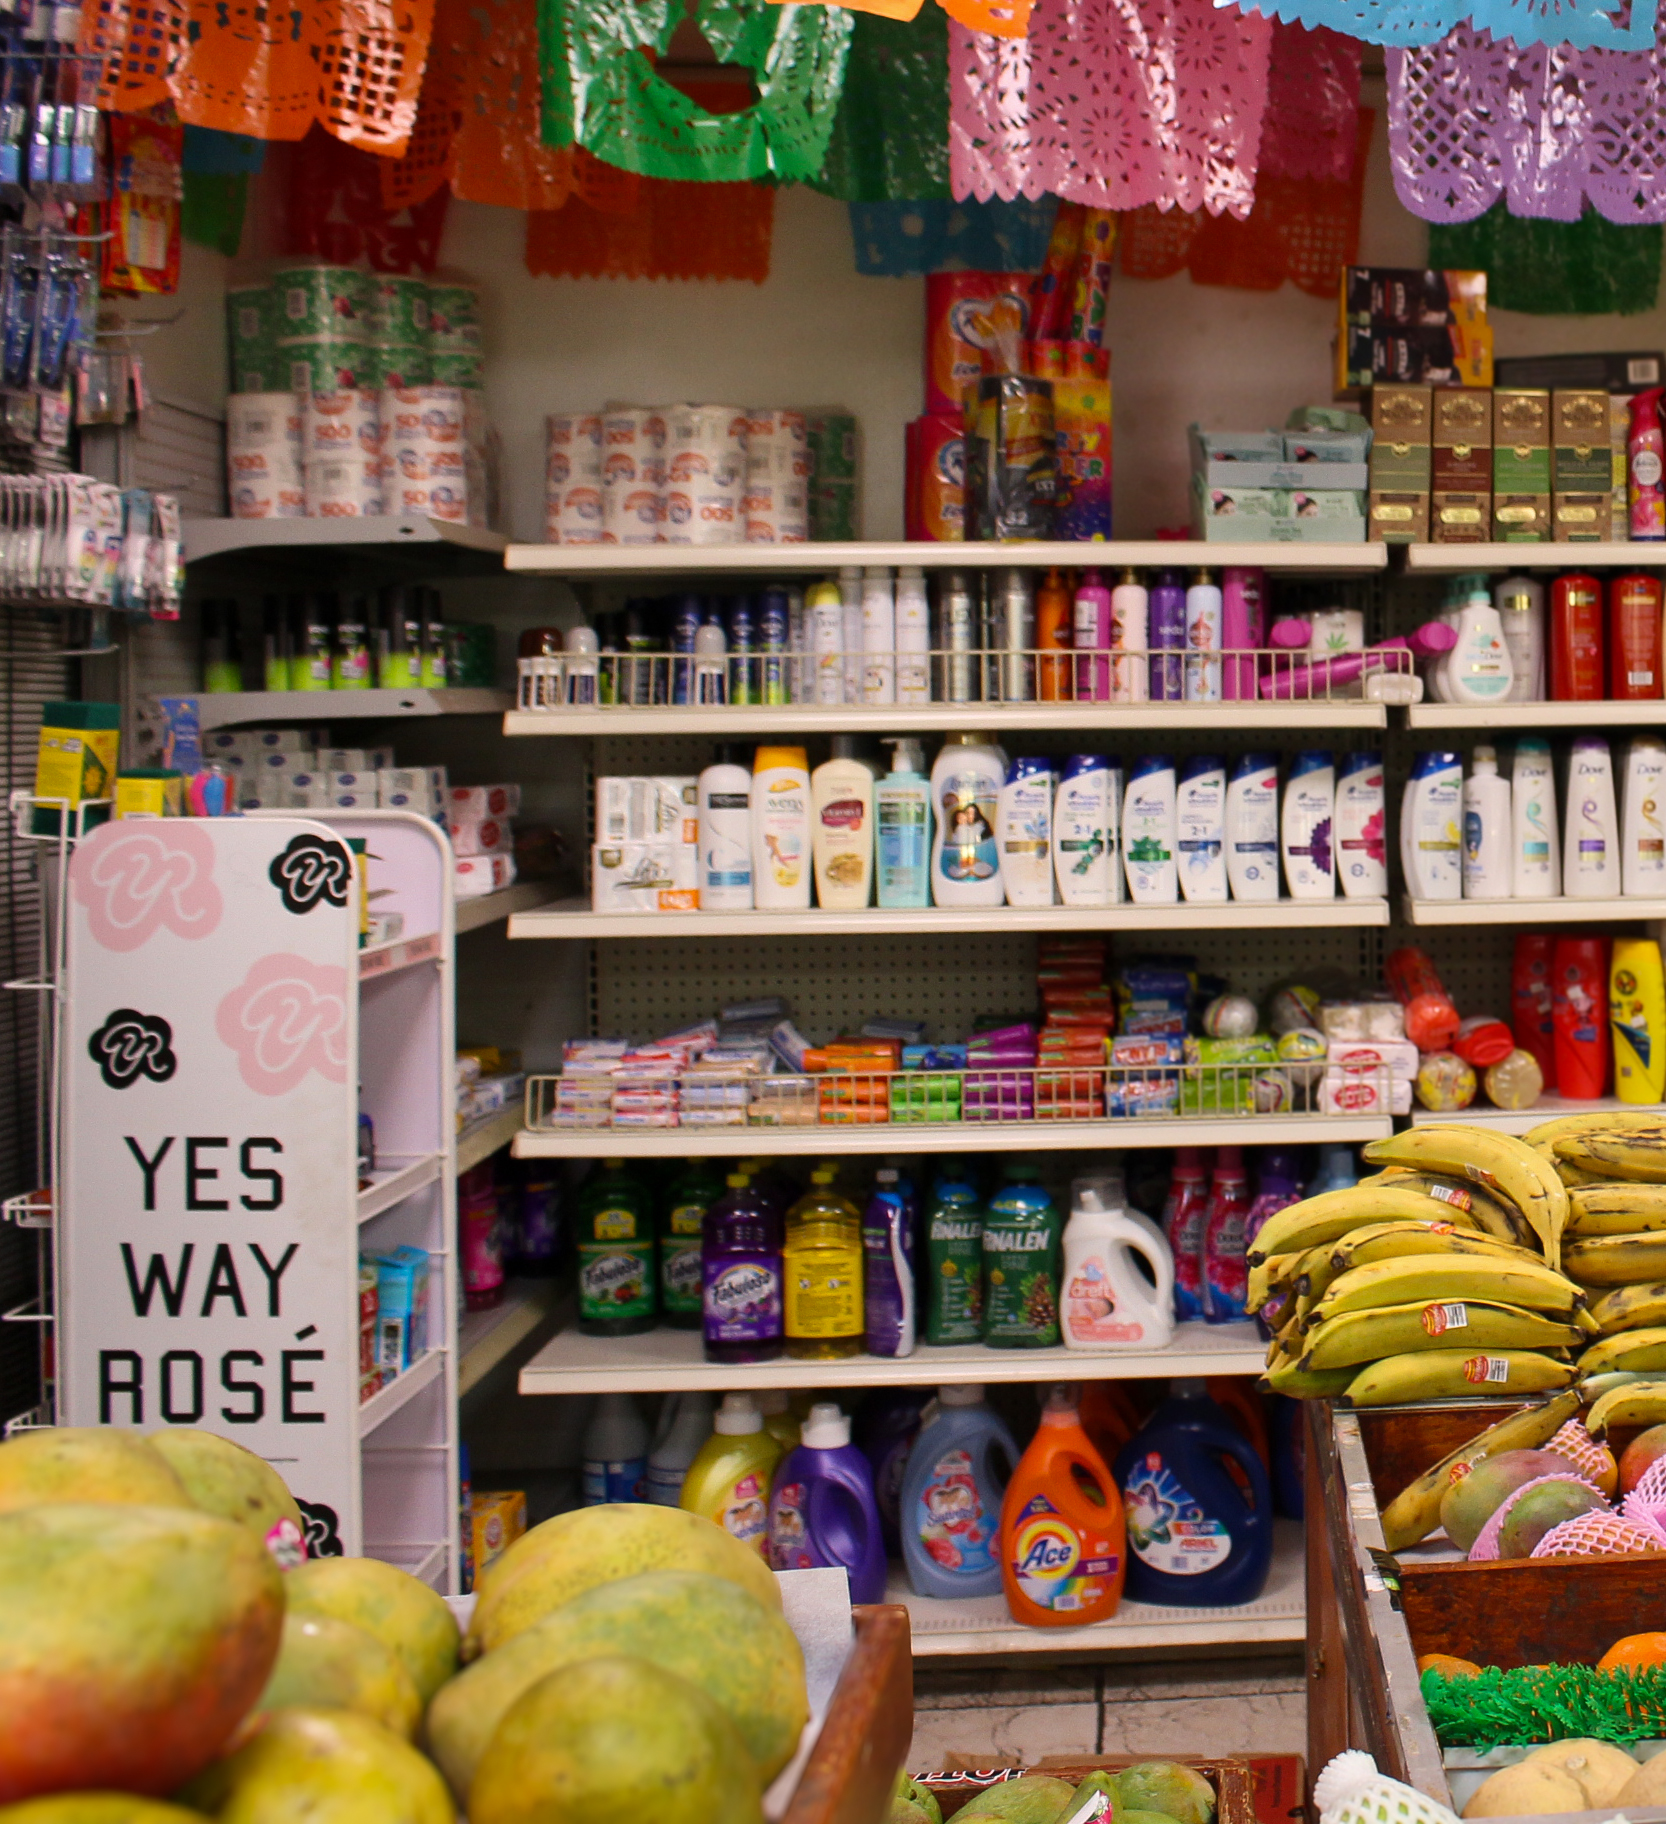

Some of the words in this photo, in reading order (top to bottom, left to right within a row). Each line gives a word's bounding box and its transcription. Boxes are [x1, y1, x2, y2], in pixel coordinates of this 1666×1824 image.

[1521, 766, 1548, 779] Dove
[1578, 762, 1606, 776] Dove
[1637, 763, 1664, 776] Dove
[124, 1135, 284, 1211] YES
[119, 1242, 300, 1318] WAY
[99, 1324, 326, 1425] ROSÉ
[1021, 1538, 1073, 1571] Ace
